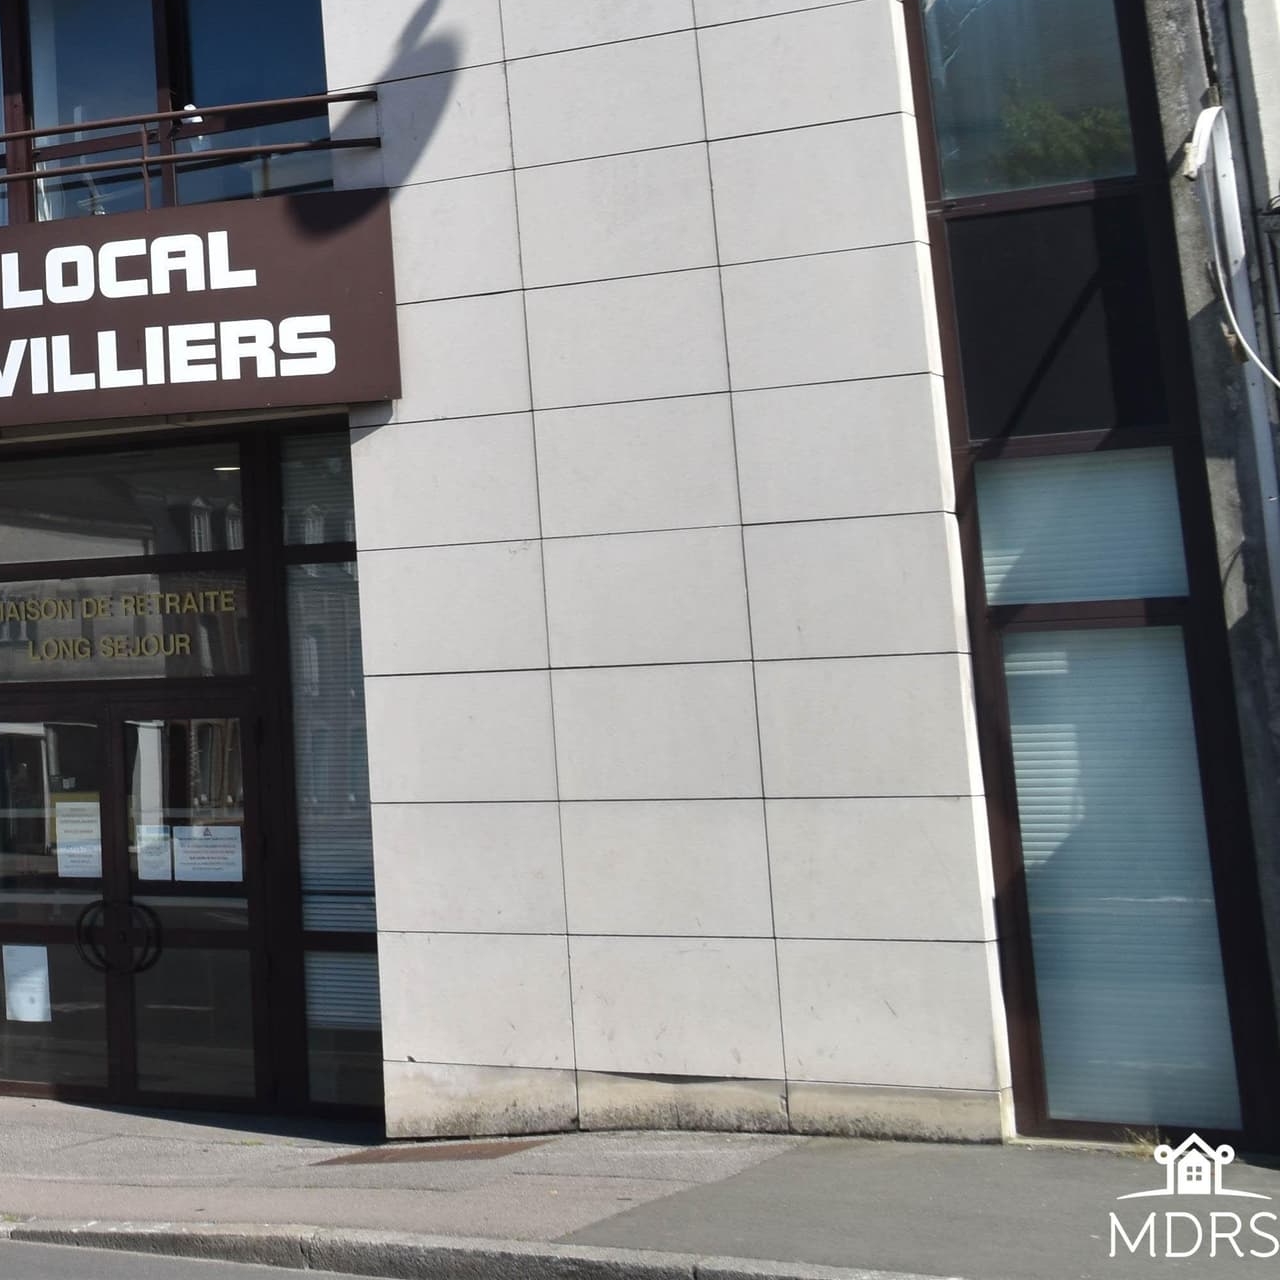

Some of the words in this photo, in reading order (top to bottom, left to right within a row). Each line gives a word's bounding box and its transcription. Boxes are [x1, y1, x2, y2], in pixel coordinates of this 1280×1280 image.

[1, 230, 257, 311] LOCAL
[81, 598, 111, 618] DE
[121, 589, 236, 616] RETRAITE
[28, 637, 91, 661] LONG
[100, 633, 191, 658] SEJOUR
